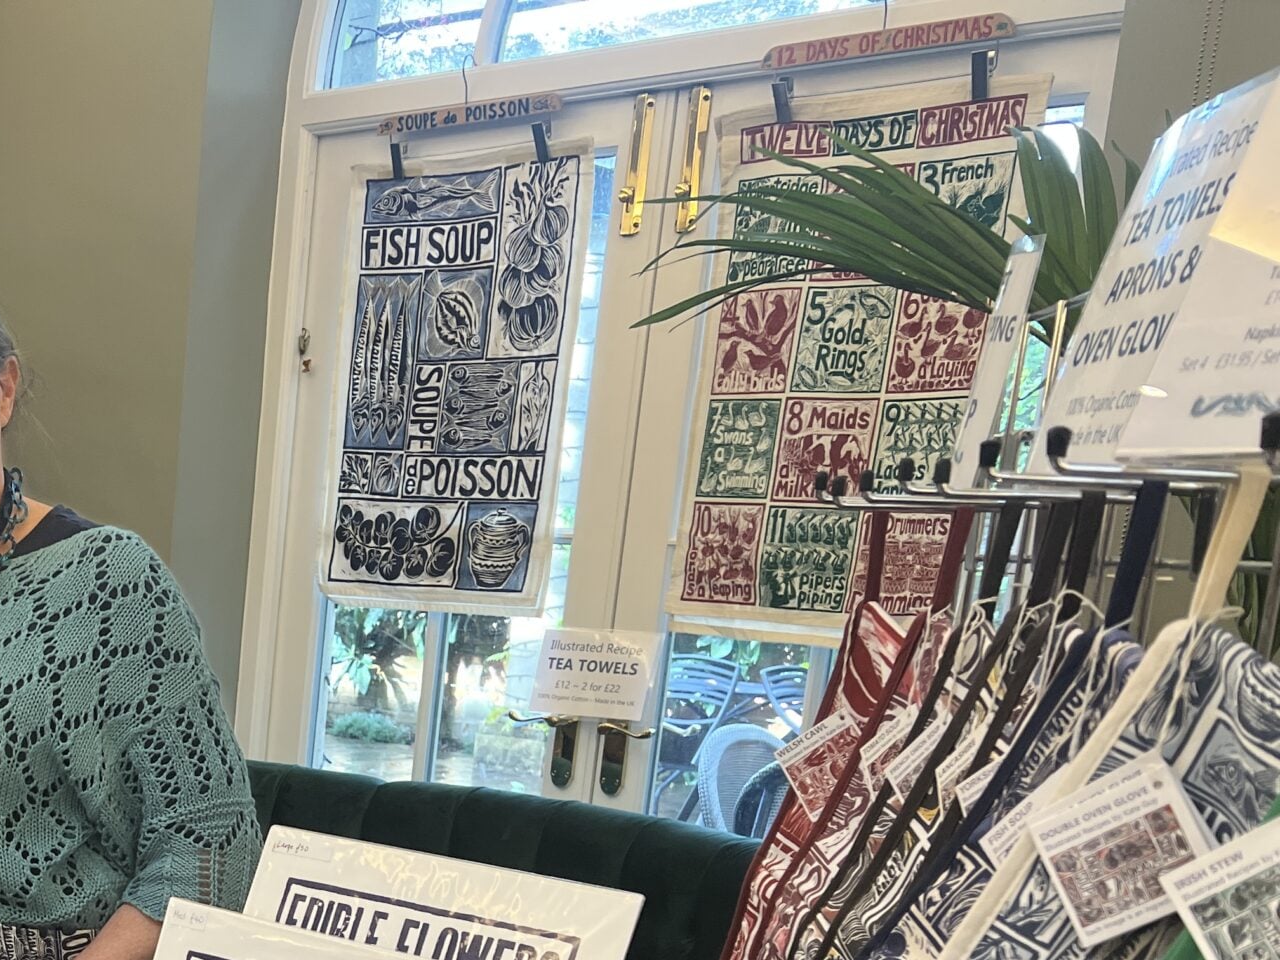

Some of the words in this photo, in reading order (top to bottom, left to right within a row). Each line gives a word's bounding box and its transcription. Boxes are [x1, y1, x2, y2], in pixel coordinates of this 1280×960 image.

[776, 47, 797, 67] 12
[805, 37, 850, 63] DAYS
[859, 32, 882, 55] OF
[891, 15, 995, 51] CHRISTMAS
[397, 111, 438, 133] SOUPE
[443, 111, 458, 126] de
[465, 98, 531, 122] POISSON
[748, 123, 829, 158] TWELVE
[835, 119, 885, 155] DAYS
[888, 112, 917, 150] OF
[920, 100, 1024, 146] CHRISTMAS
[942, 158, 994, 184] French
[364, 227, 420, 267] FISH
[426, 220, 493, 264] SOUP
[1123, 203, 1154, 249] TEA
[1104, 252, 1179, 307] APRONS
[1181, 243, 1203, 287] &
[806, 286, 827, 325] 5
[821, 318, 865, 344] Gold
[1072, 323, 1120, 369] OVEN
[815, 346, 867, 377] Rings
[407, 365, 444, 450] SOUPE
[786, 400, 804, 435] 8
[807, 407, 870, 430] Maids
[885, 404, 902, 436] 9
[417, 458, 540, 498] POISSON
[548, 657, 573, 671] TEA
[579, 659, 639, 676] TOWELS
[550, 639, 603, 653] Illustrated
[606, 643, 644, 659] Recipe
[555, 680, 570, 689] £12
[589, 682, 602, 692] for
[604, 683, 621, 694] £22
[776, 736, 805, 759] WELSH
[1039, 815, 1081, 843] DOUBLE
[1082, 801, 1113, 823] OVEN
[1113, 786, 1150, 809] GLOVE
[988, 824, 1010, 846] FISH
[1174, 869, 1207, 891] IRISH
[1207, 849, 1245, 879] STEW
